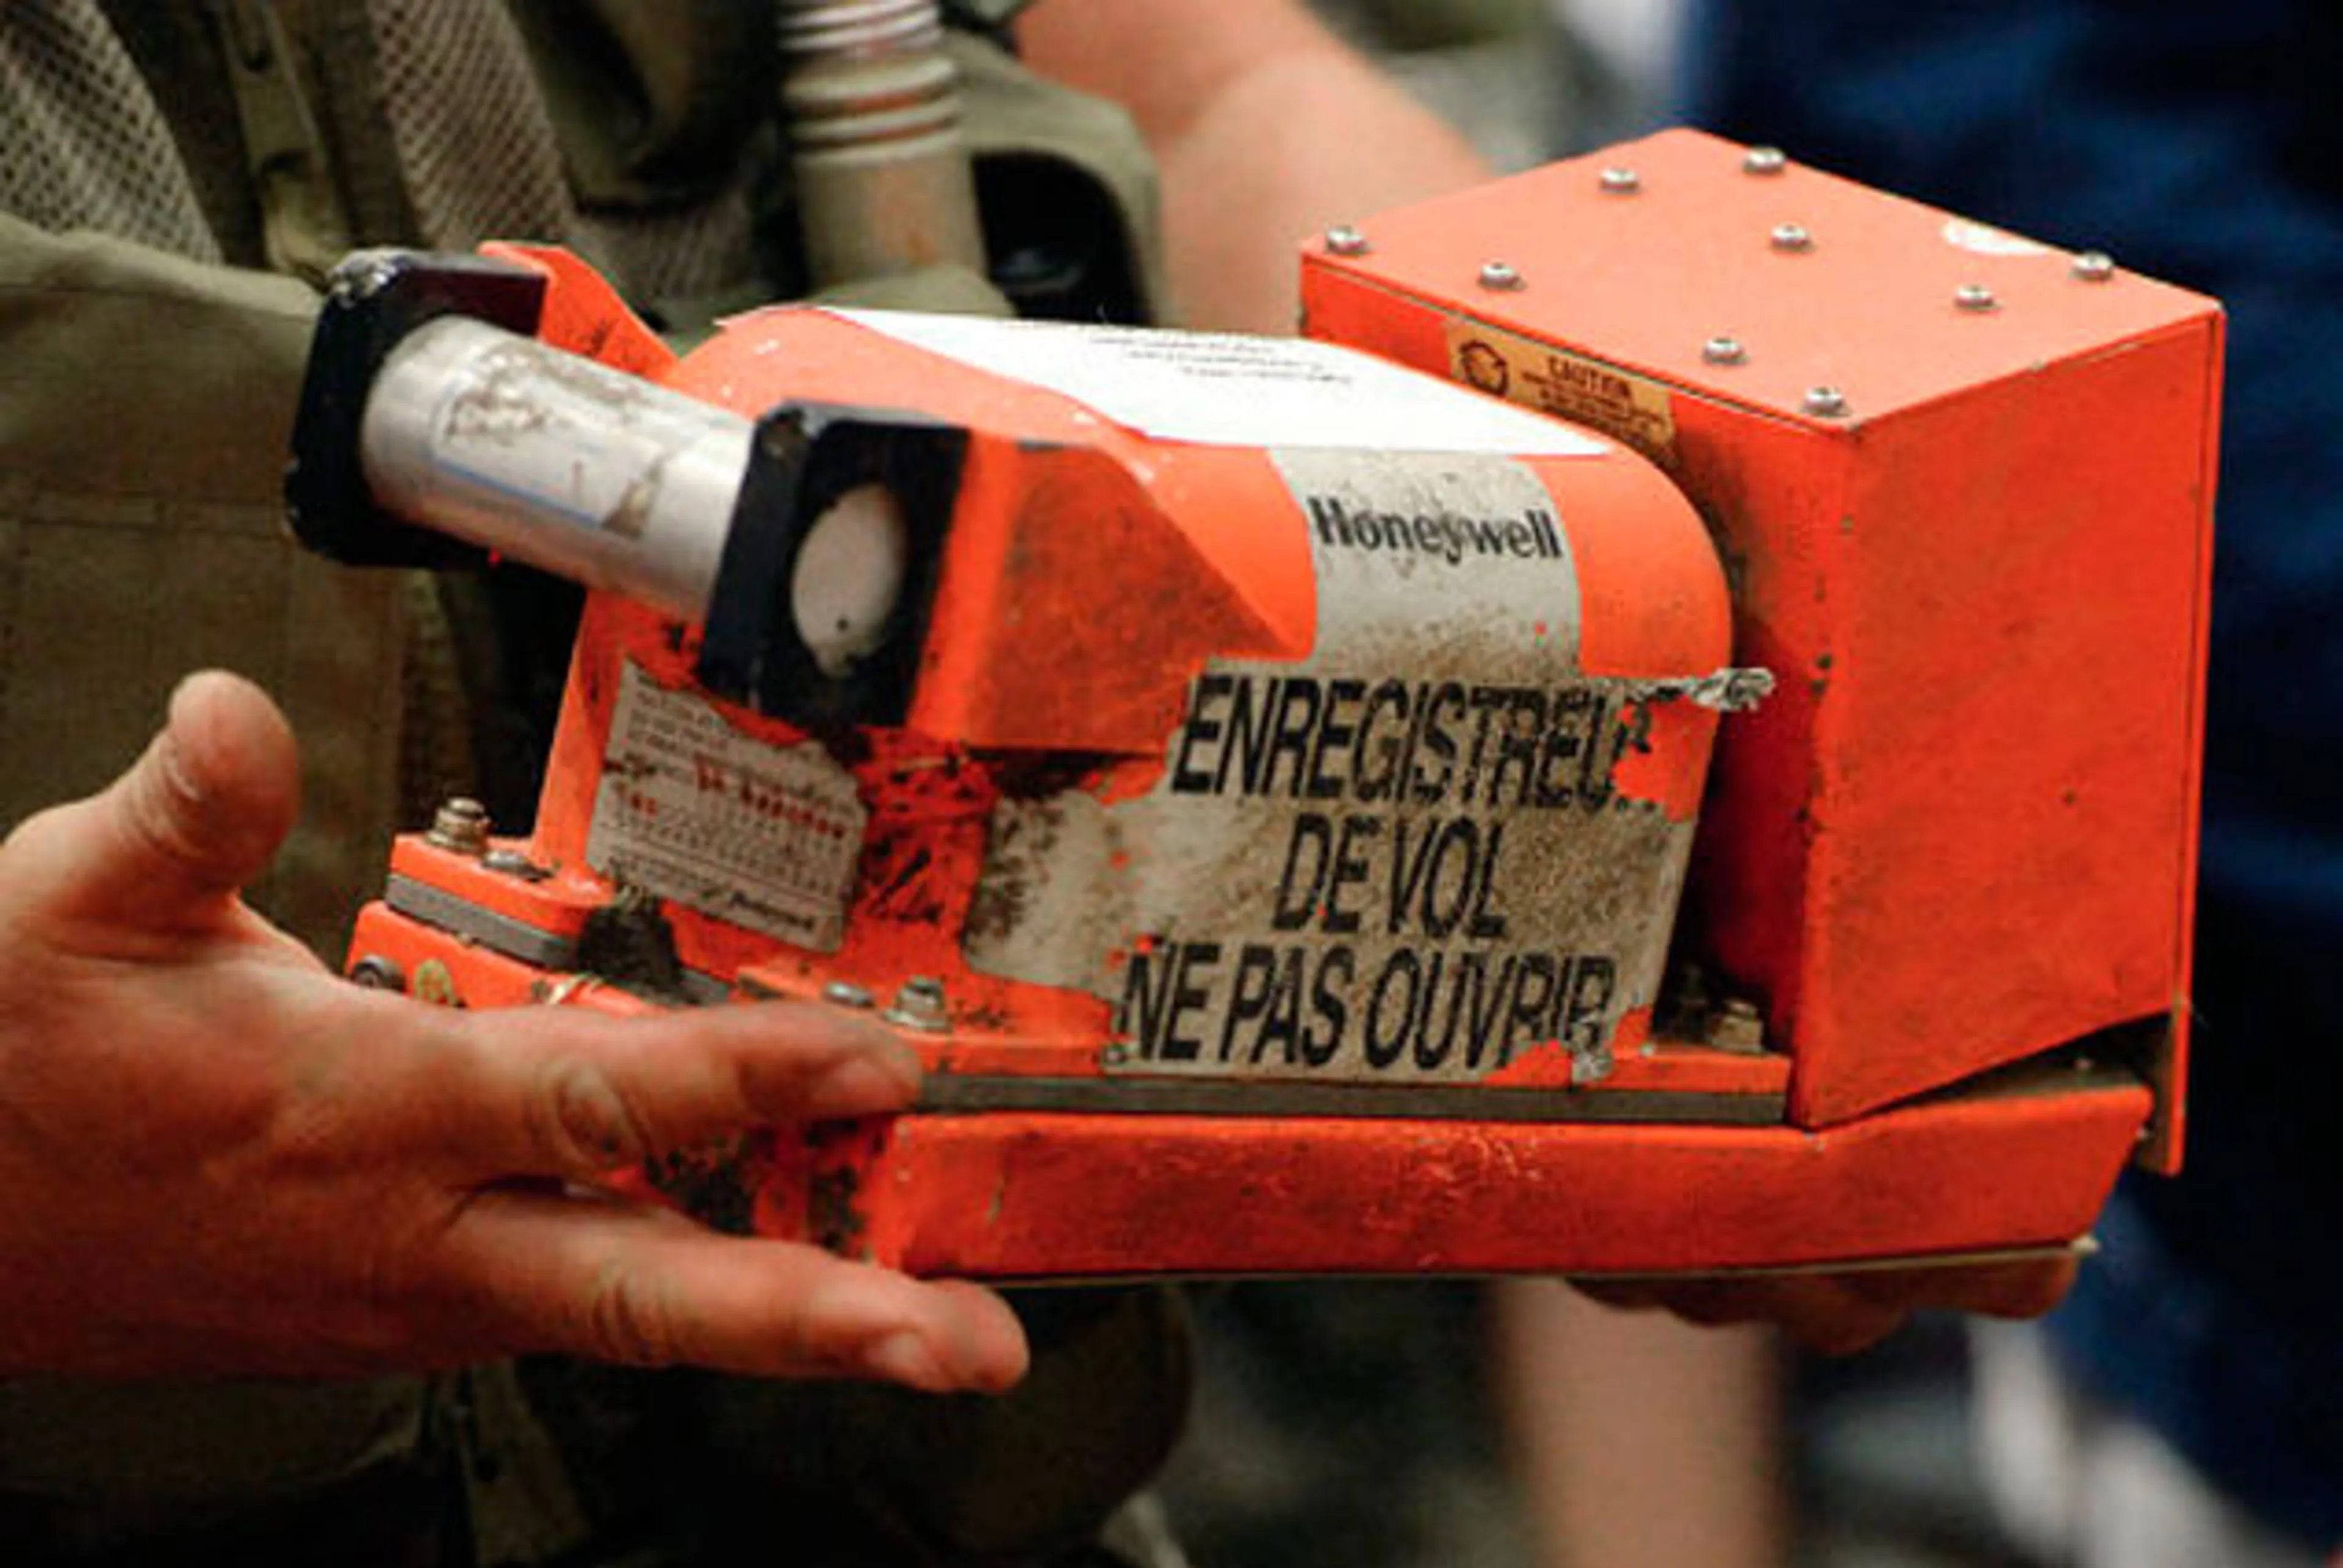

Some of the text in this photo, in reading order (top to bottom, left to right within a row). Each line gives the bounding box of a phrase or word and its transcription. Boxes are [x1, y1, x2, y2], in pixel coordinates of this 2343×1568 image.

[1307, 495, 1563, 566] Honeywell
[1274, 813, 1506, 938] DE VOL
[1118, 941, 1617, 1070] NE PAS OUVRIR
